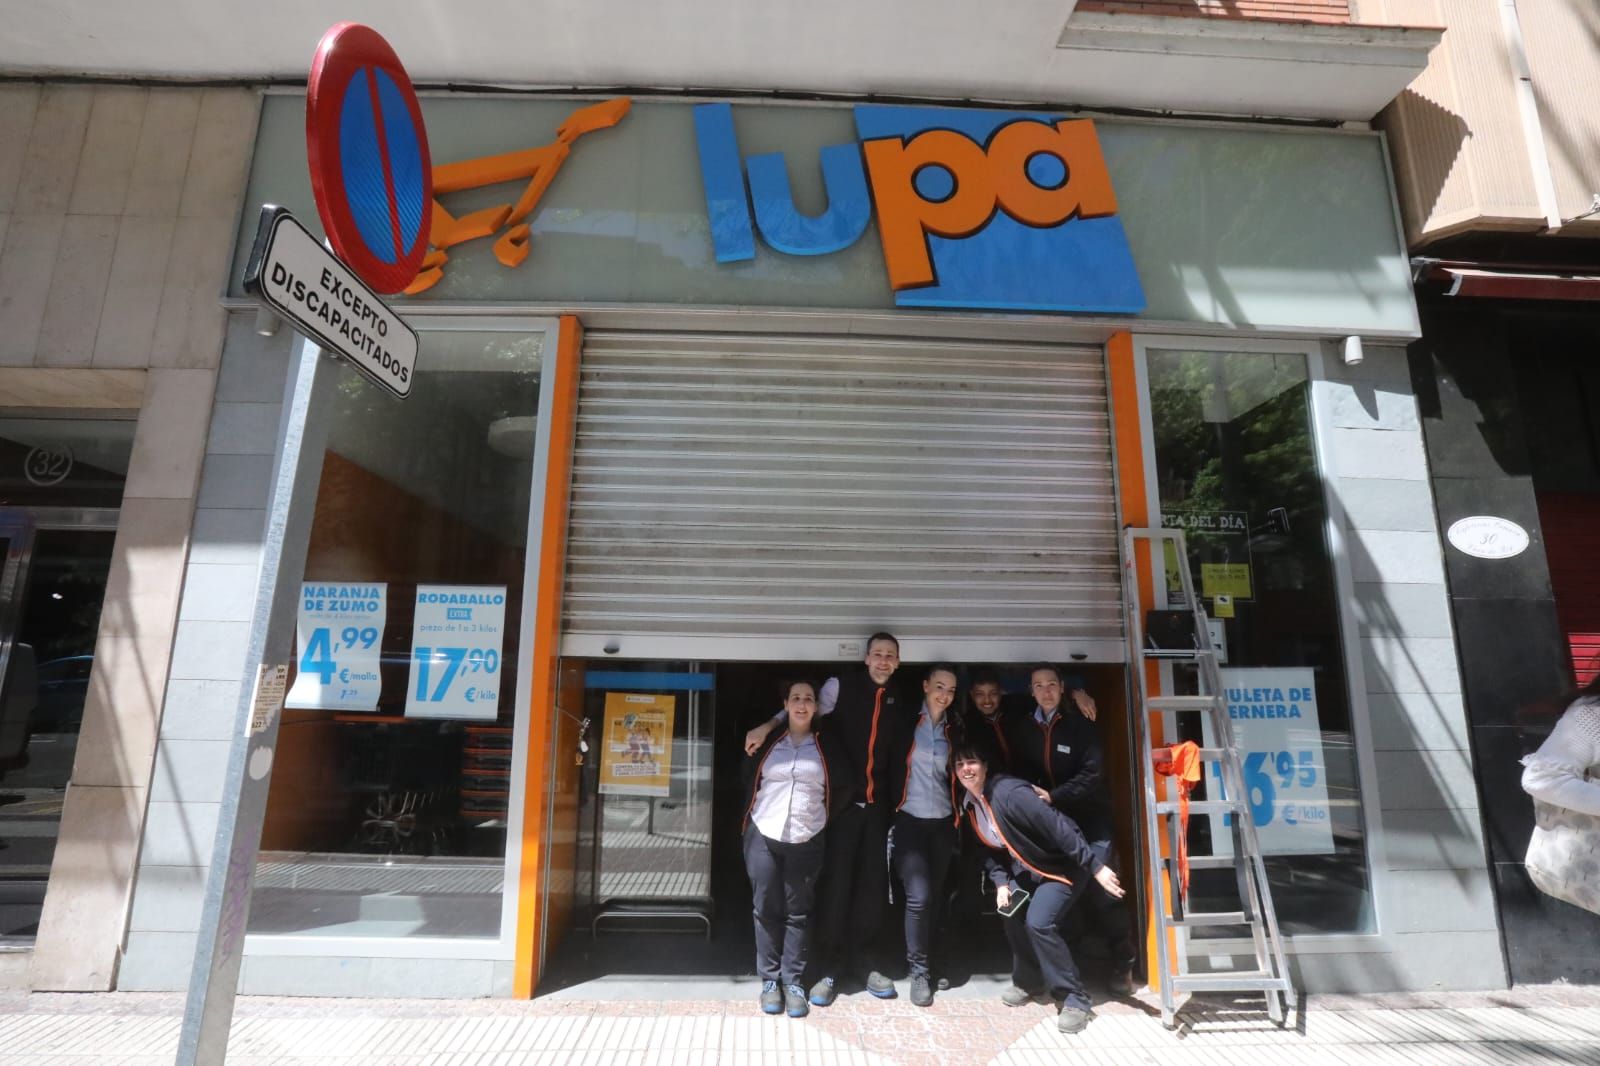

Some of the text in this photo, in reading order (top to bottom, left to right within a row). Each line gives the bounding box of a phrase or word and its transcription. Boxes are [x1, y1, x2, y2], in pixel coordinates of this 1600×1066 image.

[693, 102, 1119, 291] lupa
[320, 267, 388, 338] EXCEPTO
[271, 262, 409, 383] DISCAPACITADOS
[33, 451, 66, 476] 32
[1160, 514, 1246, 529] RTA DEL DÍA
[303, 586, 380, 600] NARANJA
[418, 592, 504, 606] RODABALLO
[304, 600, 379, 613] DE ZUMO
[445, 624, 456, 632] de
[1224, 687, 1312, 703] ULETA DE
[1229, 704, 1302, 720] ERNERA
